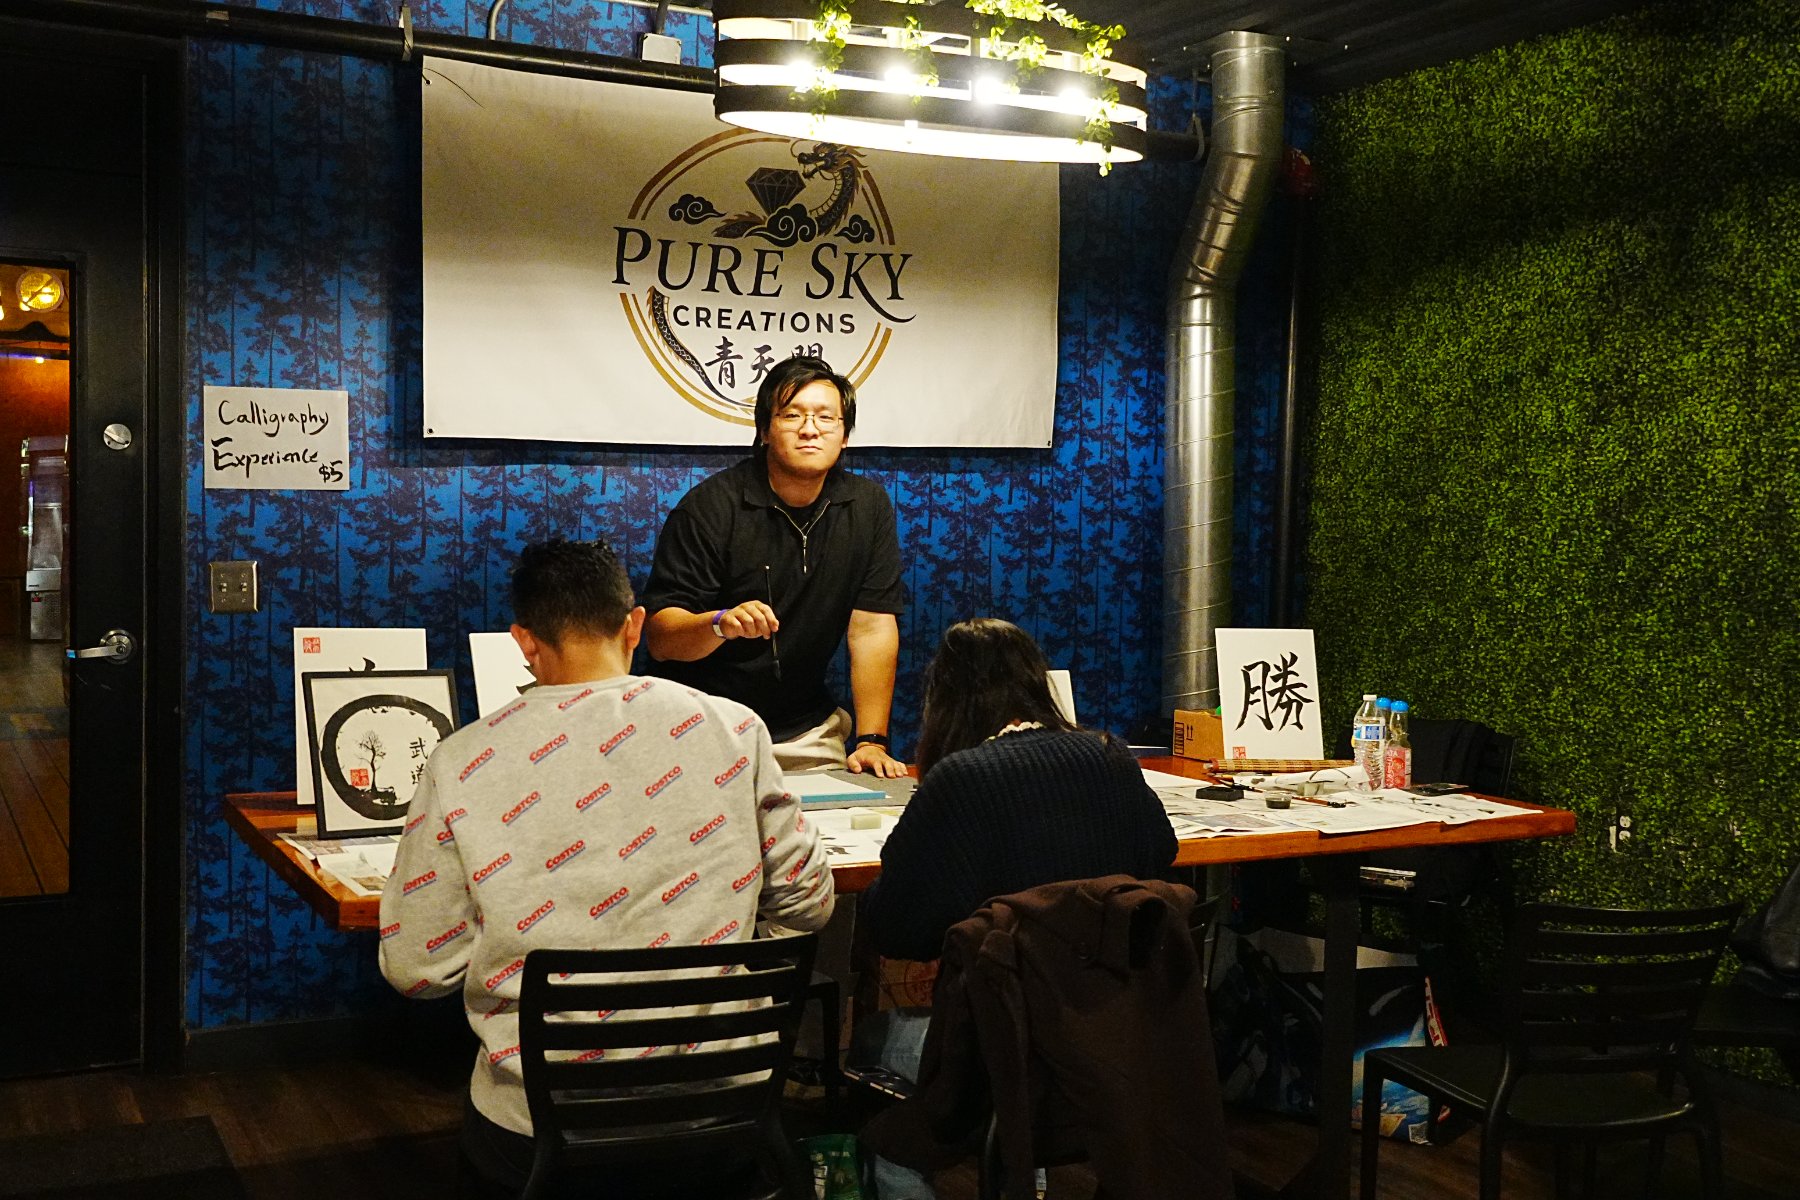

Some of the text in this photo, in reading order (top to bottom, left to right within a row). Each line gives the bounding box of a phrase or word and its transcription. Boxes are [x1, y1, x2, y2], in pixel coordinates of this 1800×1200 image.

[612, 226, 917, 323] PURE SKY
[672, 304, 856, 334] CREATIONS
[218, 400, 329, 437] Calligraphy
[211, 437, 319, 478] Experience
[318, 460, 344, 483] $5
[1235, 651, 1315, 732] 勝
[599, 723, 635, 754] COSTCO
[669, 713, 703, 737] COSTCO
[529, 733, 567, 763] COSTCO
[644, 765, 682, 797] COSTCO
[714, 756, 749, 786] COSTCO
[501, 791, 540, 824] COSTCO
[575, 782, 611, 810] COSTCO
[618, 825, 657, 859] COSTCO
[689, 814, 726, 843] COSTCO
[472, 852, 511, 883] COSTCO
[545, 839, 586, 870] COSTCO
[588, 886, 630, 918] COSTCO
[661, 871, 699, 904] COSTCO
[516, 899, 555, 932] COSTCO
[425, 920, 468, 951] COSTCO
[485, 959, 525, 990] COSTCO
